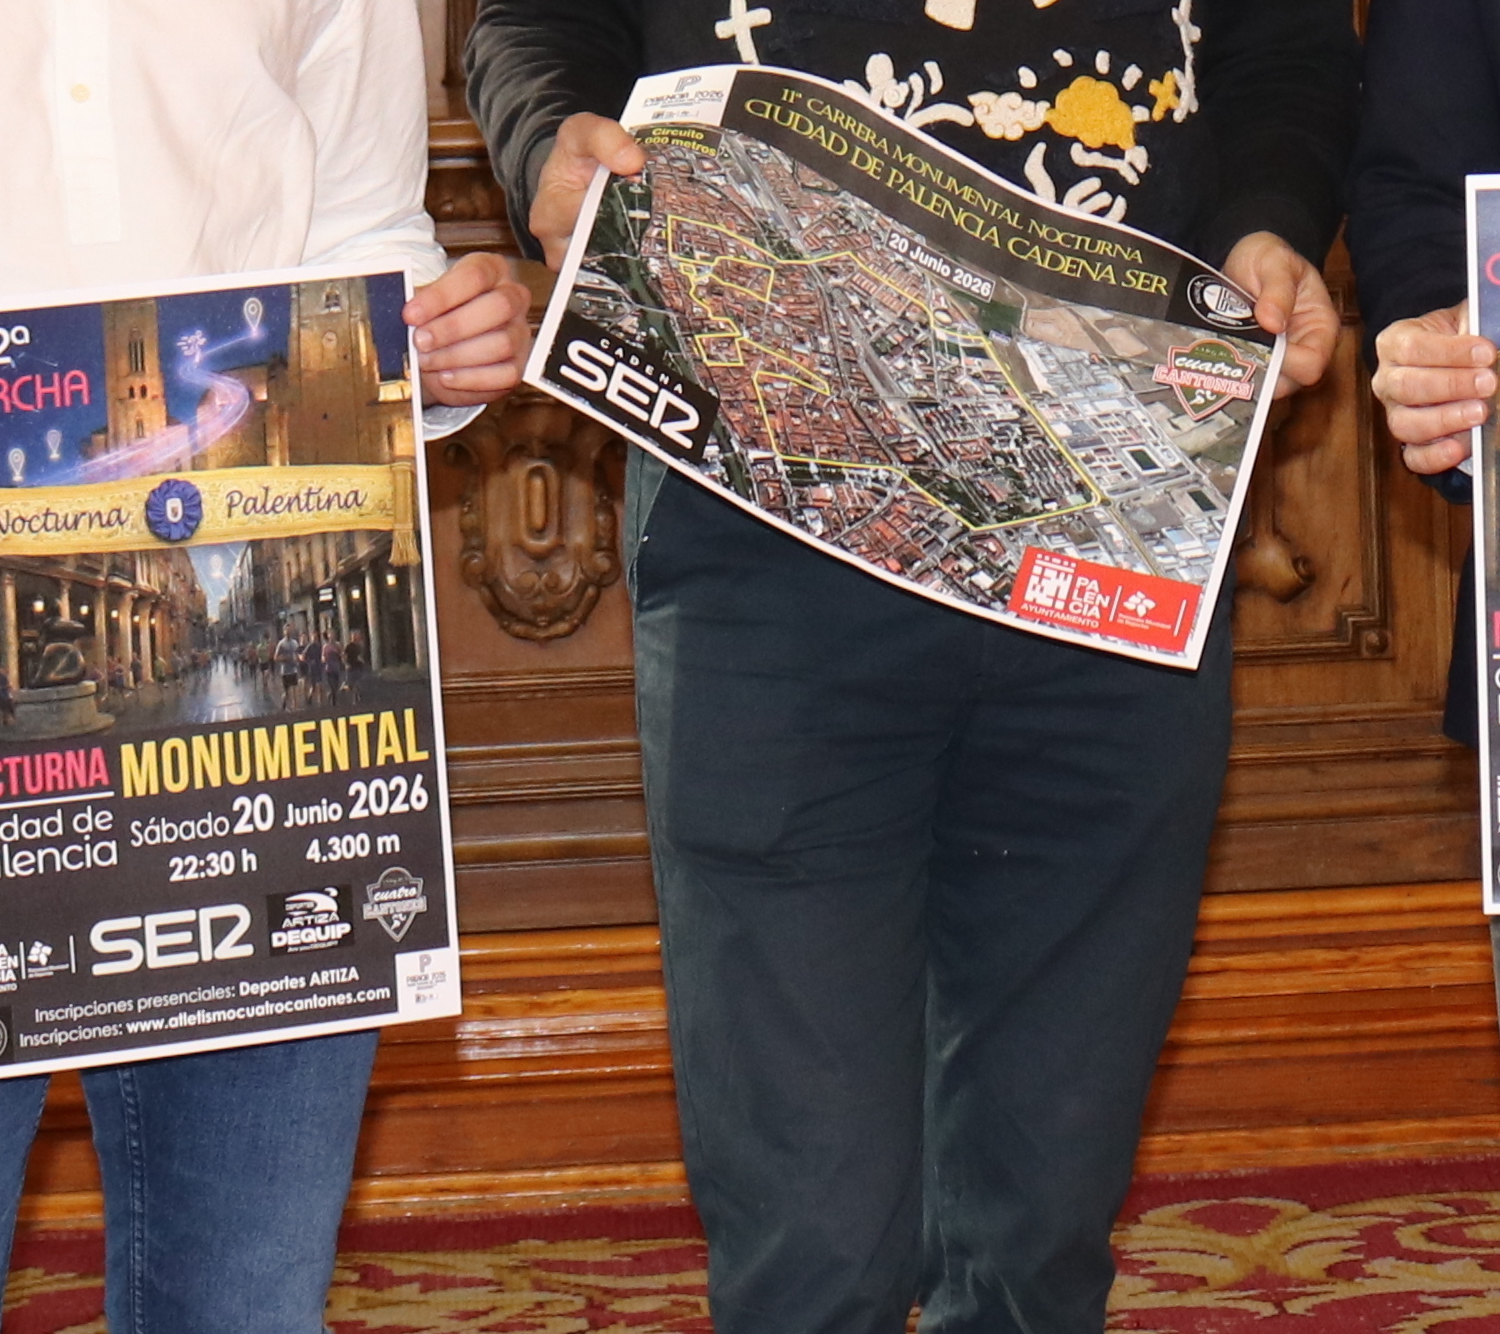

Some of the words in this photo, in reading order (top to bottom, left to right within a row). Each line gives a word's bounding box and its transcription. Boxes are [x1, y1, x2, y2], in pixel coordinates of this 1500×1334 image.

[651, 127, 705, 140] Circuito
[670, 138, 717, 157] metros
[806, 98, 890, 156] CARRERA
[892, 143, 1024, 231] MONUMENTAL
[1027, 218, 1144, 264] NOCTURNA
[744, 98, 849, 157] CIUDAD
[849, 145, 885, 181] DE
[885, 167, 1001, 249] PALENCIA
[1007, 235, 1118, 286] CADENA
[1121, 268, 1170, 297] SER
[887, 231, 911, 254] 20
[909, 245, 952, 278] Junio
[952, 267, 993, 297] 2026
[599, 338, 684, 395] CADENA
[1155, 367, 1252, 397] CANTONES
[1174, 356, 1243, 379] cuatro
[558, 339, 700, 450] SER
[226, 486, 367, 518] Palentina
[1071, 588, 1111, 608] LEN
[1075, 575, 1100, 593] PA
[1020, 603, 1100, 629] AYUNTAMIENTO
[1068, 602, 1101, 619] CIA
[121, 709, 427, 797] MONUMENTAL
[72, 804, 114, 833] de
[130, 811, 229, 847] Sábado
[232, 792, 274, 834] 20
[284, 797, 342, 827] Junio
[348, 773, 427, 819] 2026
[308, 833, 370, 863] 4.300
[376, 833, 400, 854] m
[168, 850, 235, 881] 22:30
[241, 848, 256, 873] h
[90, 904, 252, 974] SER
[271, 922, 350, 947] DEQUIP
[35, 998, 133, 1022] Inscripciones
[137, 985, 235, 1012] presenciales:
[239, 974, 305, 996] Deportes
[309, 966, 359, 986] ARTIZA
[19, 1023, 122, 1048] Inscripciones:
[125, 987, 390, 1033] www.atletismocuatrocantones.com
